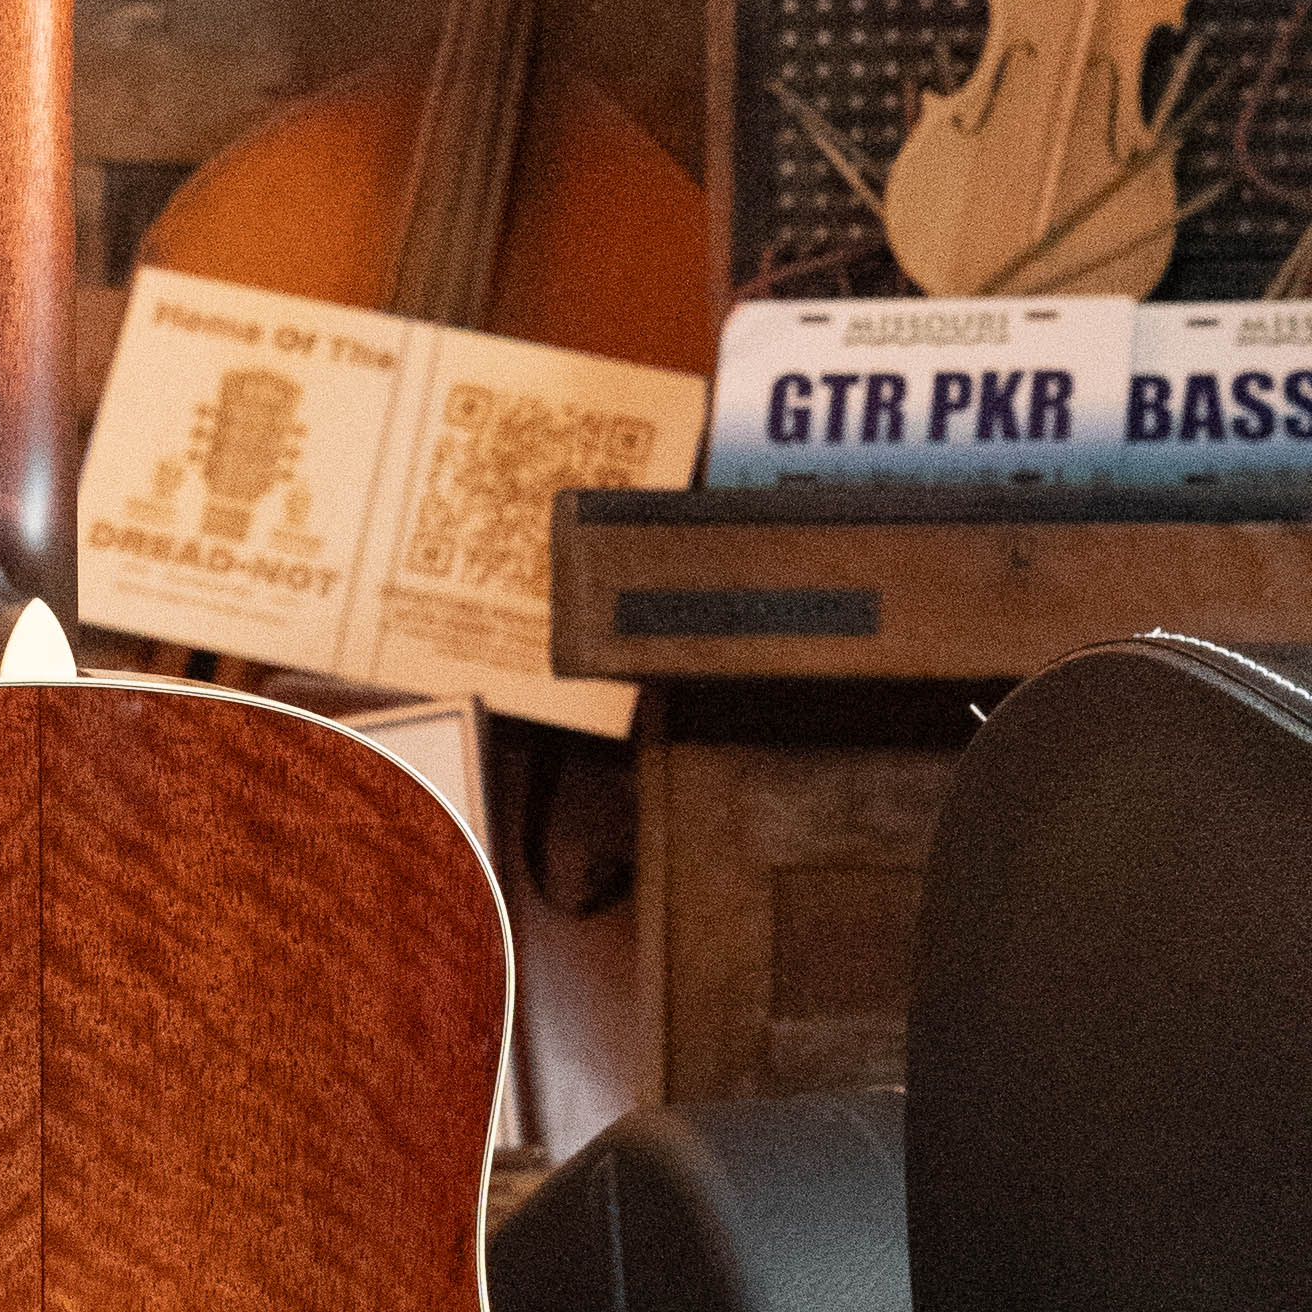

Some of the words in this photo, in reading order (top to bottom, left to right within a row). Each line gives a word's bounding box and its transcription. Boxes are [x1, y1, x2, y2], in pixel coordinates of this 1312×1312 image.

[152, 299, 264, 349] Home
[766, 371, 909, 445] GTR
[925, 369, 1075, 443] PKR
[87, 519, 342, 600] DREAD-NOT
